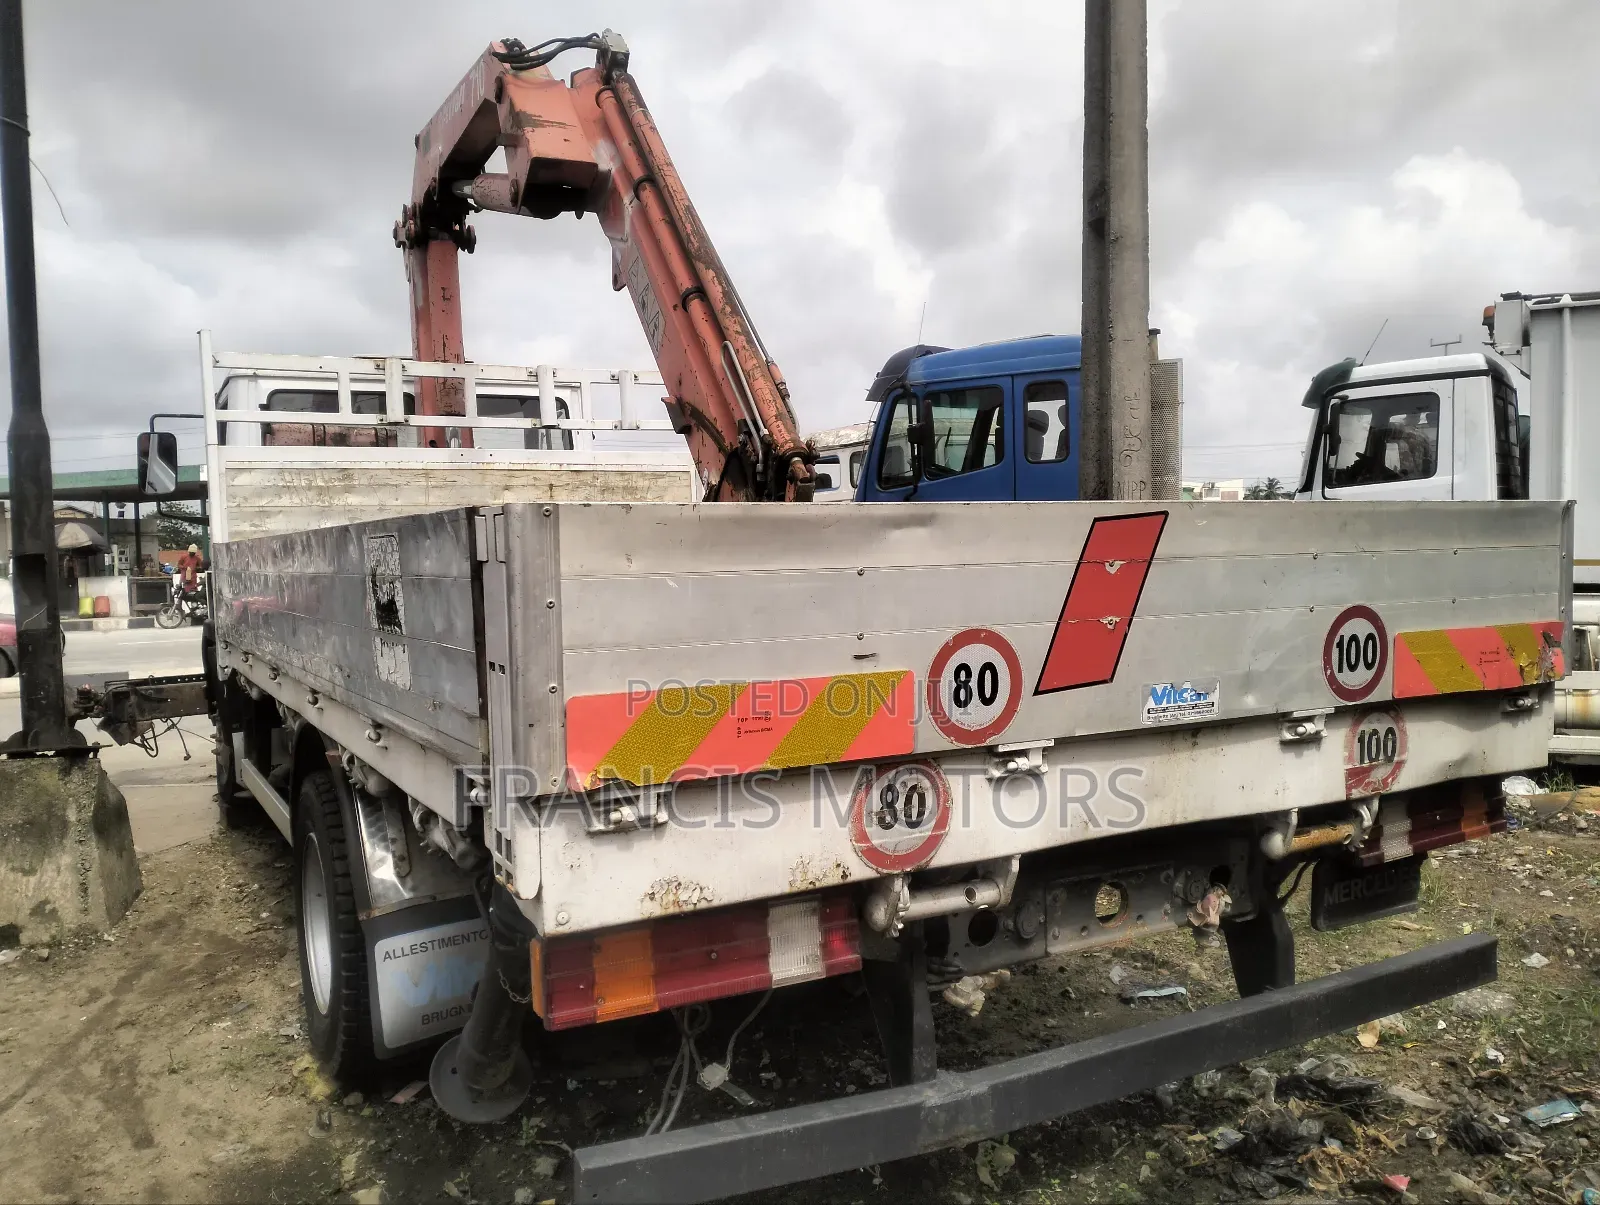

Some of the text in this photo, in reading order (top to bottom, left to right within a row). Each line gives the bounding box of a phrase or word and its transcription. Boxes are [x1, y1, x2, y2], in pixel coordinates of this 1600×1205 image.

[1335, 632, 1378, 674] 100
[953, 661, 999, 708] 80
[1358, 727, 1397, 765] 100
[877, 782, 926, 830] 80
